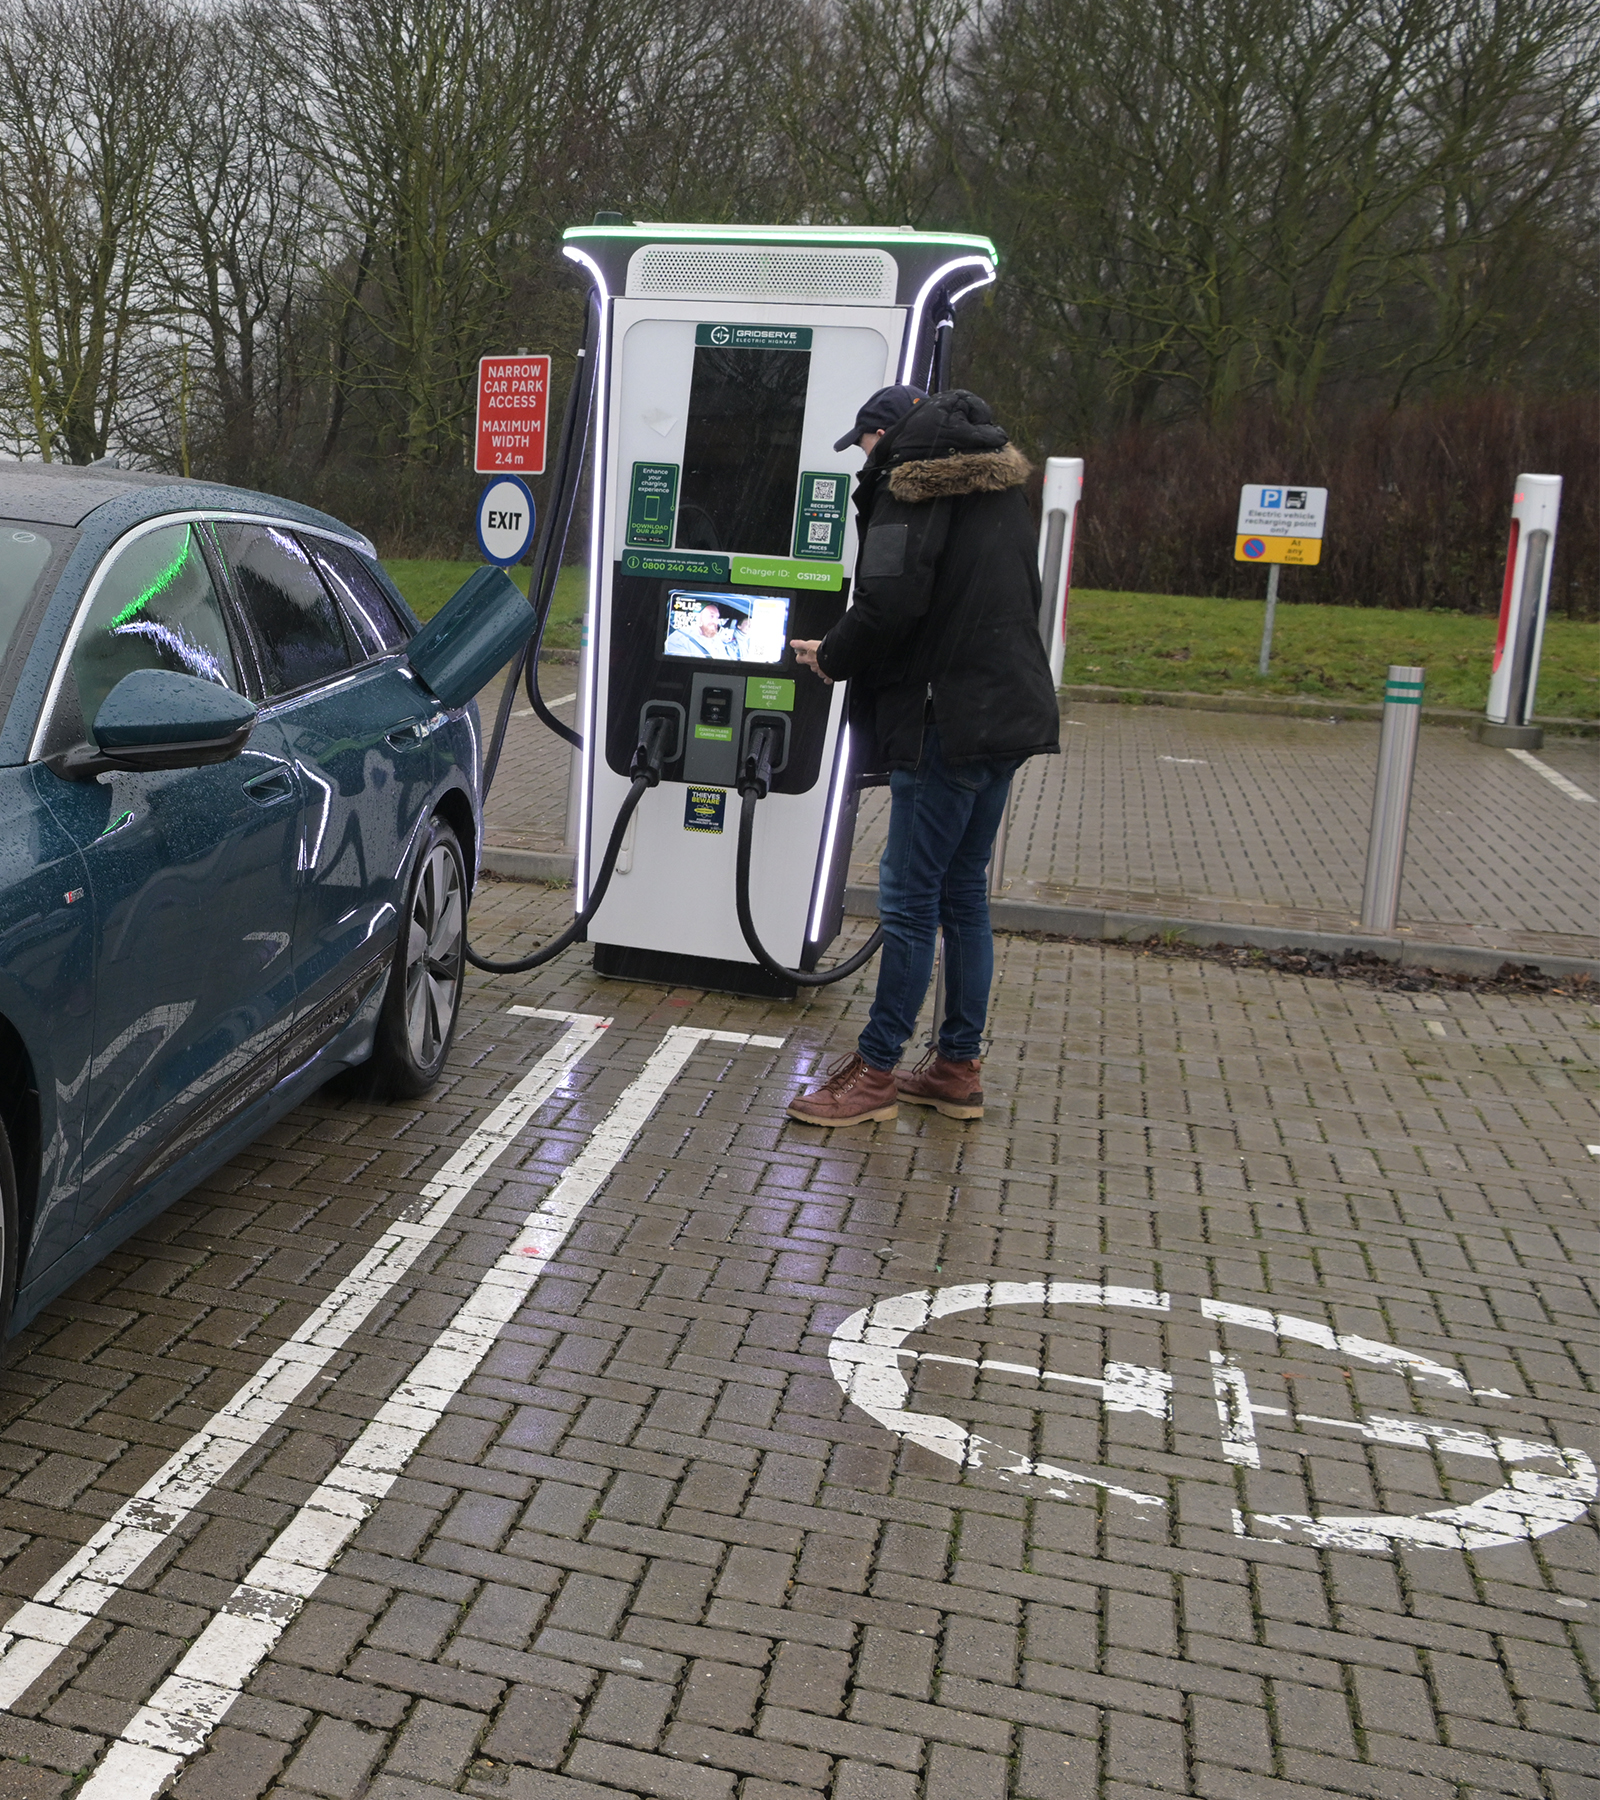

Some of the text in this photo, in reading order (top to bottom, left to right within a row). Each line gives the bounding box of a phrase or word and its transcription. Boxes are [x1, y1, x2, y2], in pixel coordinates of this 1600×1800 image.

[736, 330, 798, 339] GRIDSERVE
[488, 365, 541, 378] NARROW
[484, 380, 543, 393] CAR PARK
[488, 395, 536, 408] ACCESS
[482, 420, 541, 432] MAXIMUM
[491, 435, 530, 448] WIDTH
[495, 452, 524, 464] 2.4 m
[641, 480, 668, 488] charging
[1248, 509, 1315, 520] Electric vehicle
[487, 510, 522, 531] EXIT
[1245, 518, 1292, 527] recharging
[631, 523, 669, 531] DOWNLOAD
[1270, 527, 1289, 535] only
[1287, 548, 1304, 556] any
[642, 562, 709, 574] 0800 240 4242
[740, 566, 831, 582] Charger ID: GS11291
[678, 601, 702, 611] PLUS
[691, 796, 720, 805] BEWARE
[692, 791, 720, 799] THIEVES
